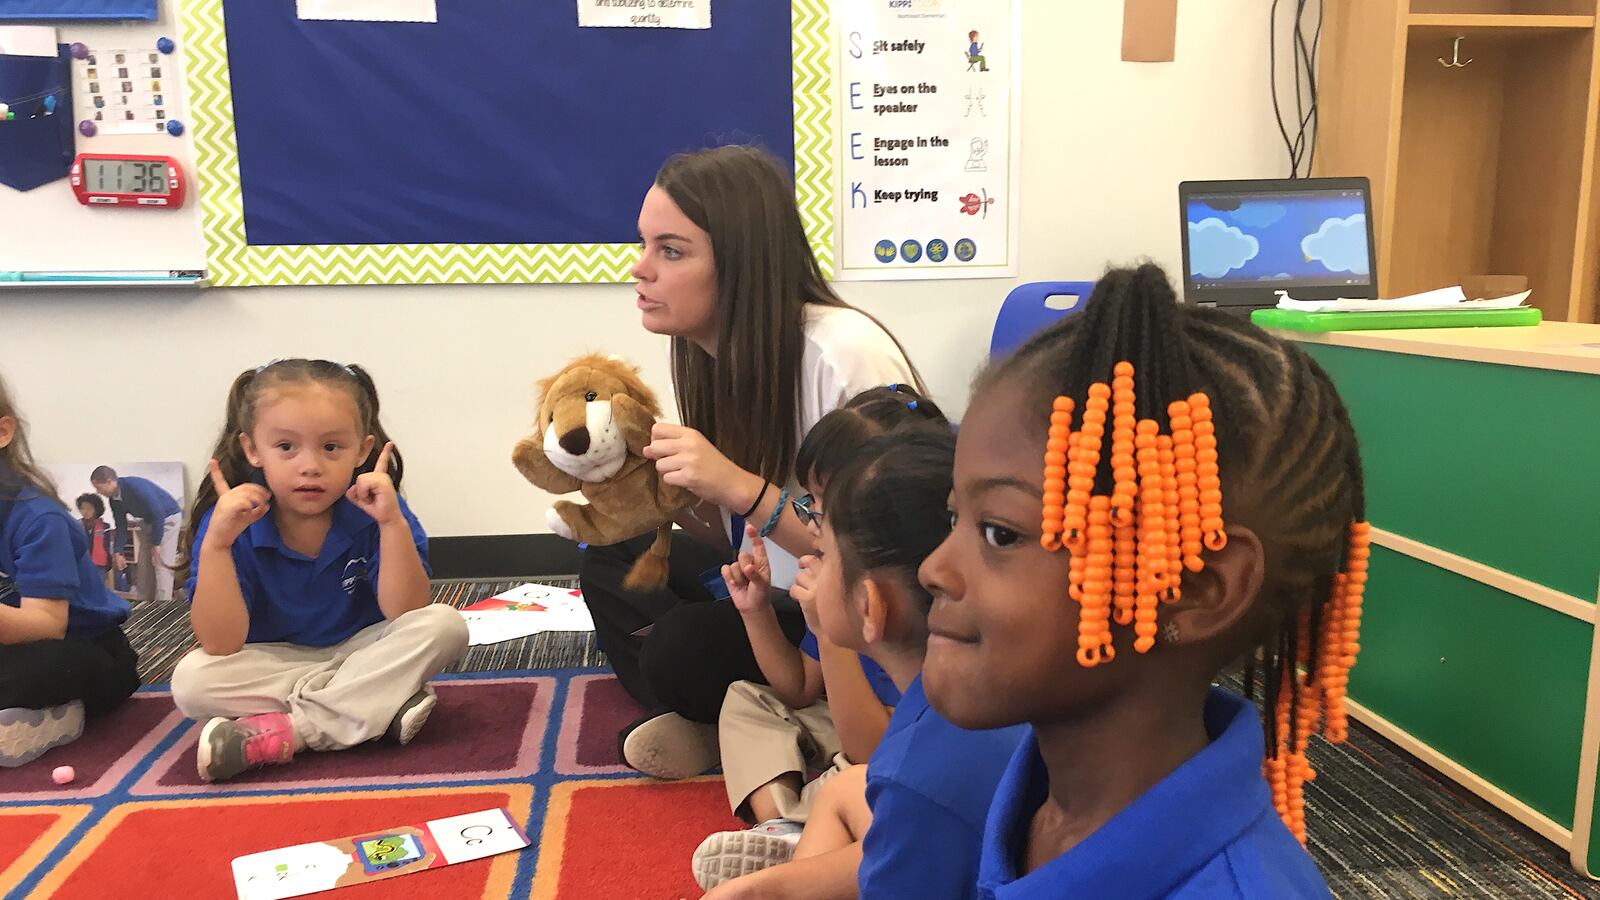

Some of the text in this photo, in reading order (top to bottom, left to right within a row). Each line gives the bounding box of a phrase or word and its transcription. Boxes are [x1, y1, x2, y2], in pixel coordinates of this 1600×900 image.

[873, 39, 925, 54] Sit safely
[850, 82, 864, 109] E
[873, 82, 937, 97] Eyes on the
[873, 101, 918, 116] speaker
[850, 132, 864, 160] E
[874, 136, 949, 151] Engage in the
[874, 155, 909, 166] lesson
[852, 182, 867, 209] K
[874, 188, 939, 203] Keep trying
